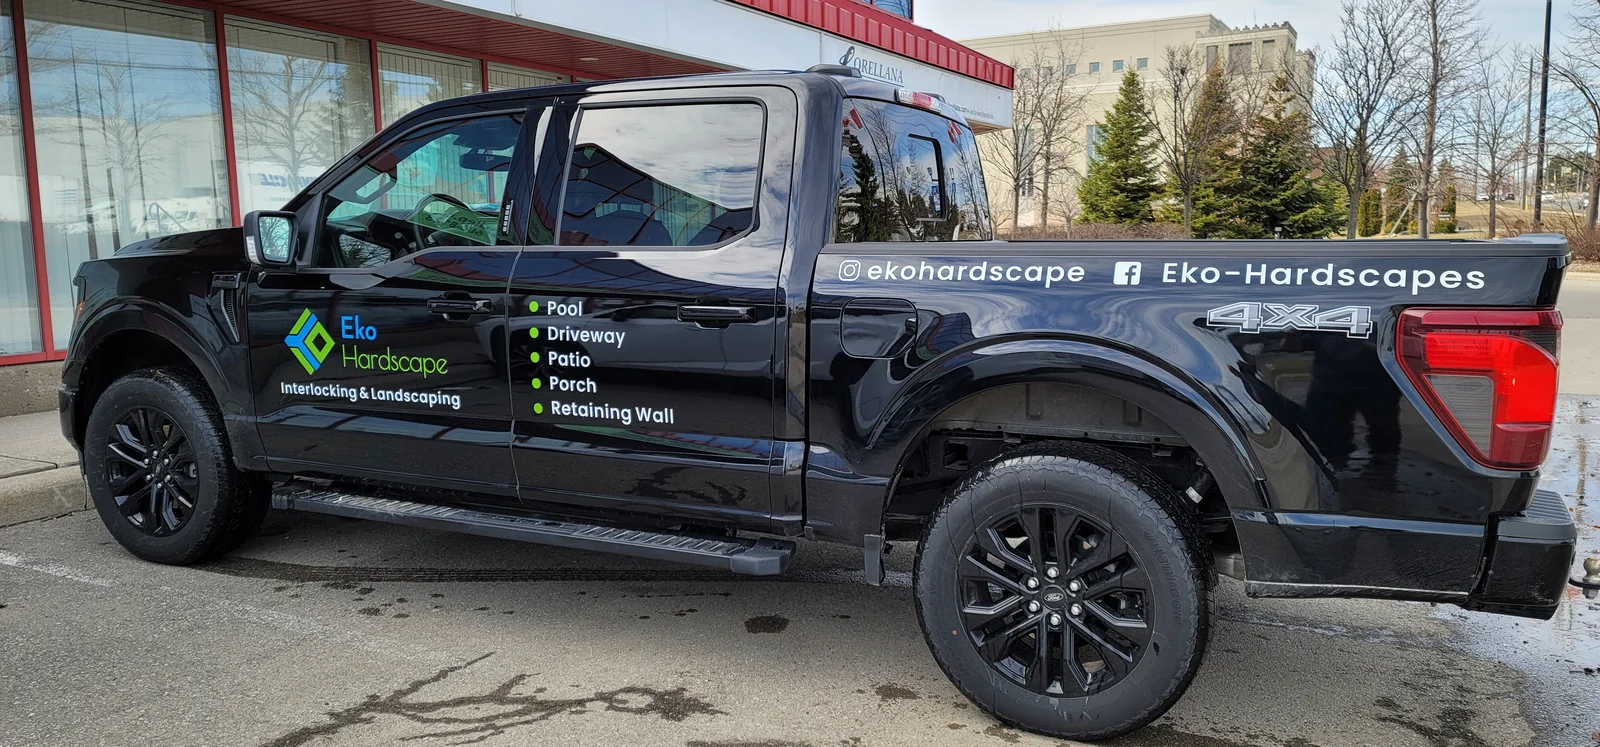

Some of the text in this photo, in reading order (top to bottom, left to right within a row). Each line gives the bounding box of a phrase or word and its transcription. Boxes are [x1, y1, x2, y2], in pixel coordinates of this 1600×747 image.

[853, 57, 904, 84] ORELLANA
[867, 261, 1085, 288] ekohardscape
[1162, 261, 1485, 295] Eko-Hardscapes
[547, 301, 583, 317] Pool
[340, 315, 377, 341] Eko
[547, 326, 626, 349] Driveway
[342, 344, 448, 379] Hardscape
[548, 351, 592, 368] Patio
[280, 381, 461, 410] Interlocking & Landscaping
[549, 376, 597, 393] Porch
[551, 401, 675, 426] Retaining Wall
